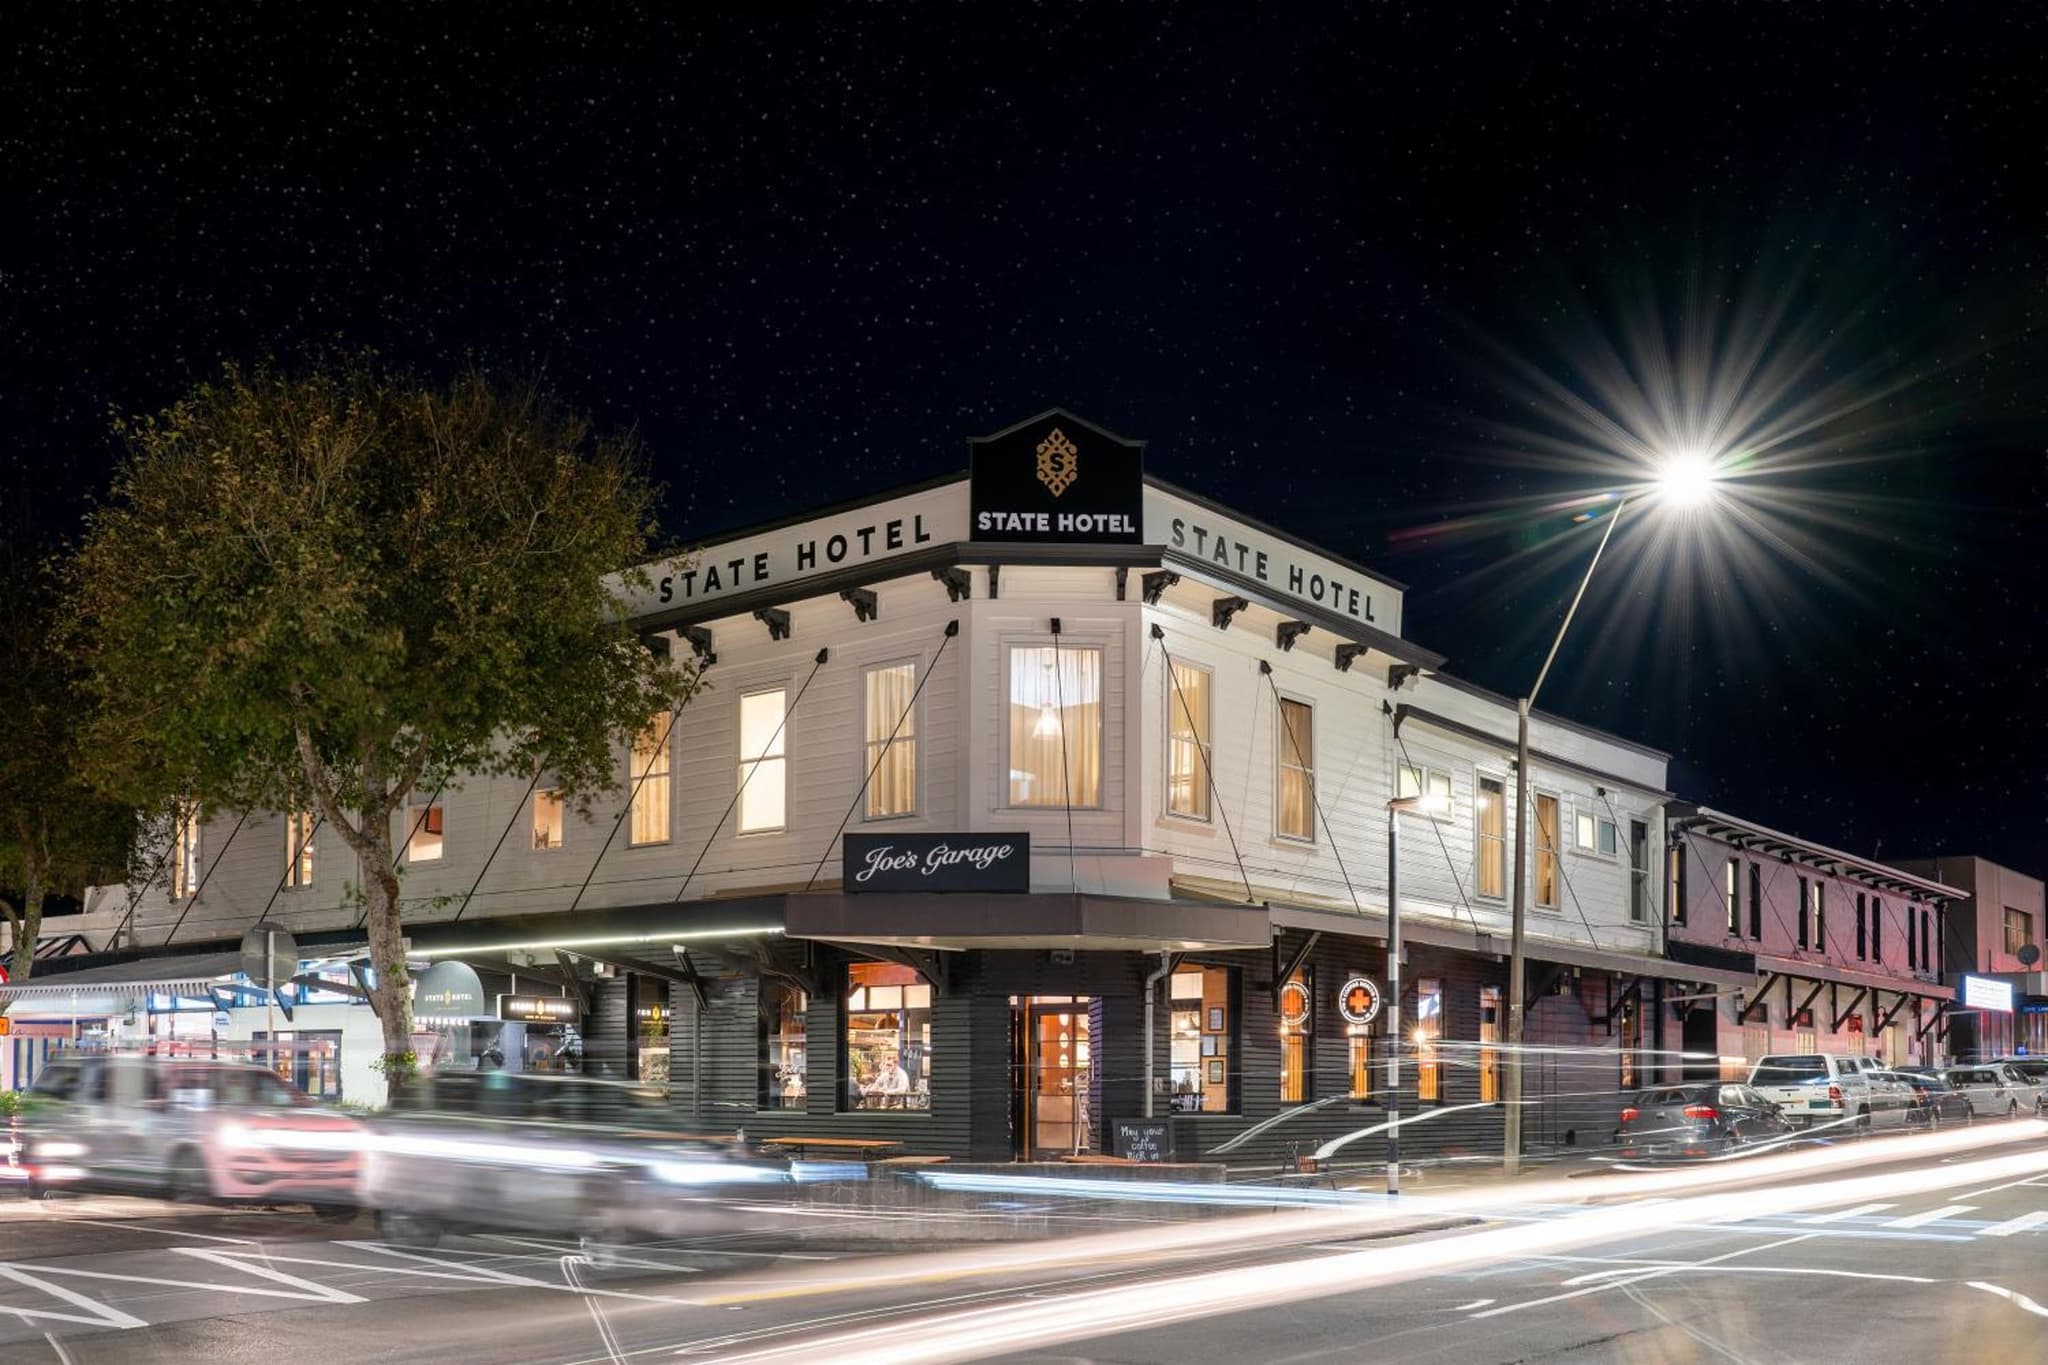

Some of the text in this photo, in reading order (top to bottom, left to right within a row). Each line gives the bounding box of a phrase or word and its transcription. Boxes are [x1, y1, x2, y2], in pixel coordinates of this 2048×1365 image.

[1050, 453, 1064, 472] S
[978, 511, 1135, 533] STATE HOTEL
[659, 515, 930, 603] STATE HOTEL
[1171, 518, 1375, 622] STATE HOTEL
[856, 843, 1014, 882] Joe's Garage
